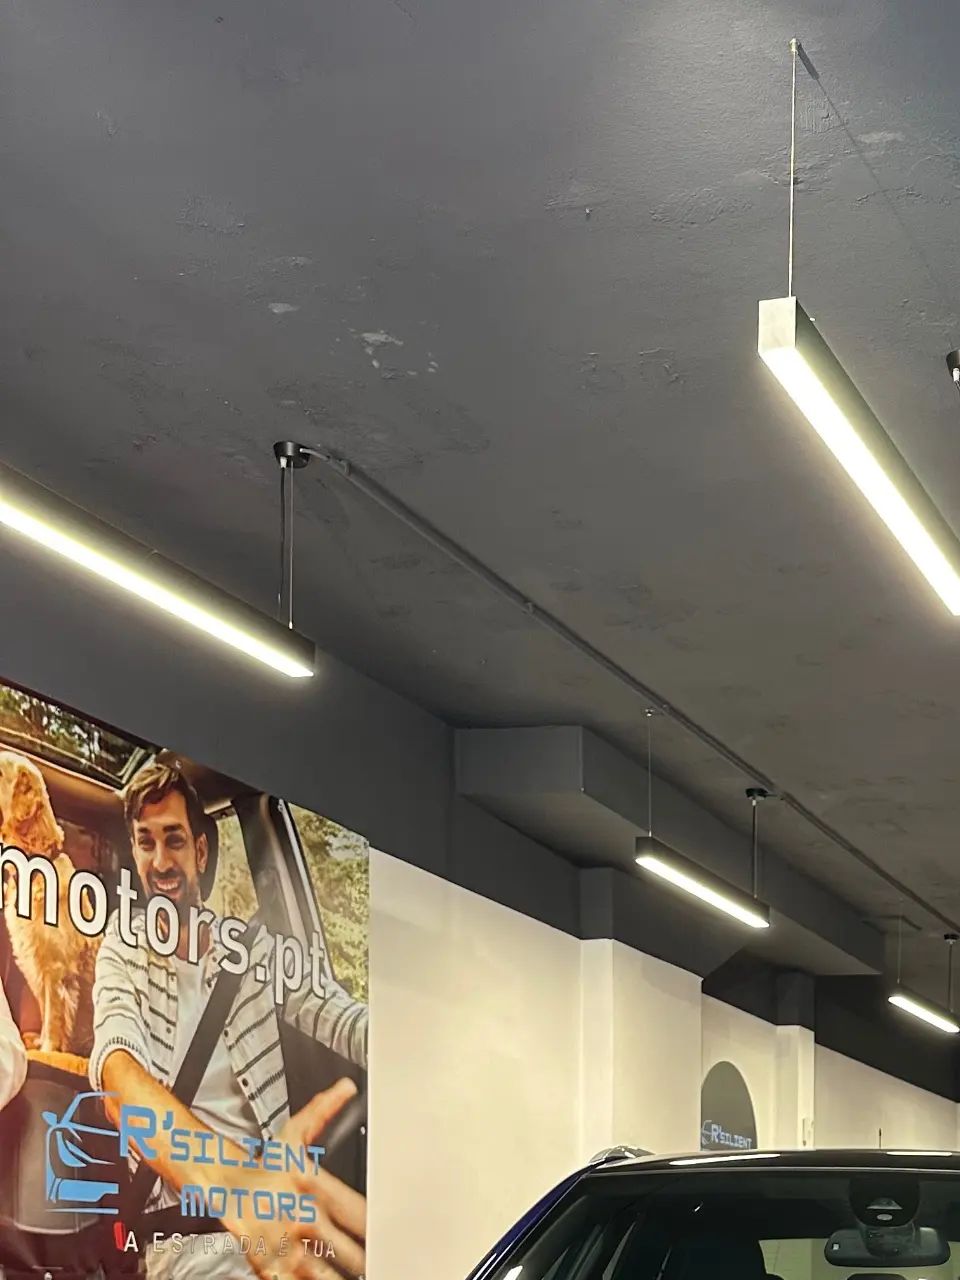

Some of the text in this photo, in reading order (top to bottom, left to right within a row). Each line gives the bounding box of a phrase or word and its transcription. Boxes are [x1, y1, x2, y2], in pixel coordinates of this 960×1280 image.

[0, 845, 327, 1005] motors.pt
[180, 1184, 319, 1223] MOTORS
[123, 1231, 139, 1253] A
[152, 1231, 267, 1257] ESTRADA
[301, 1238, 336, 1259] TUA
